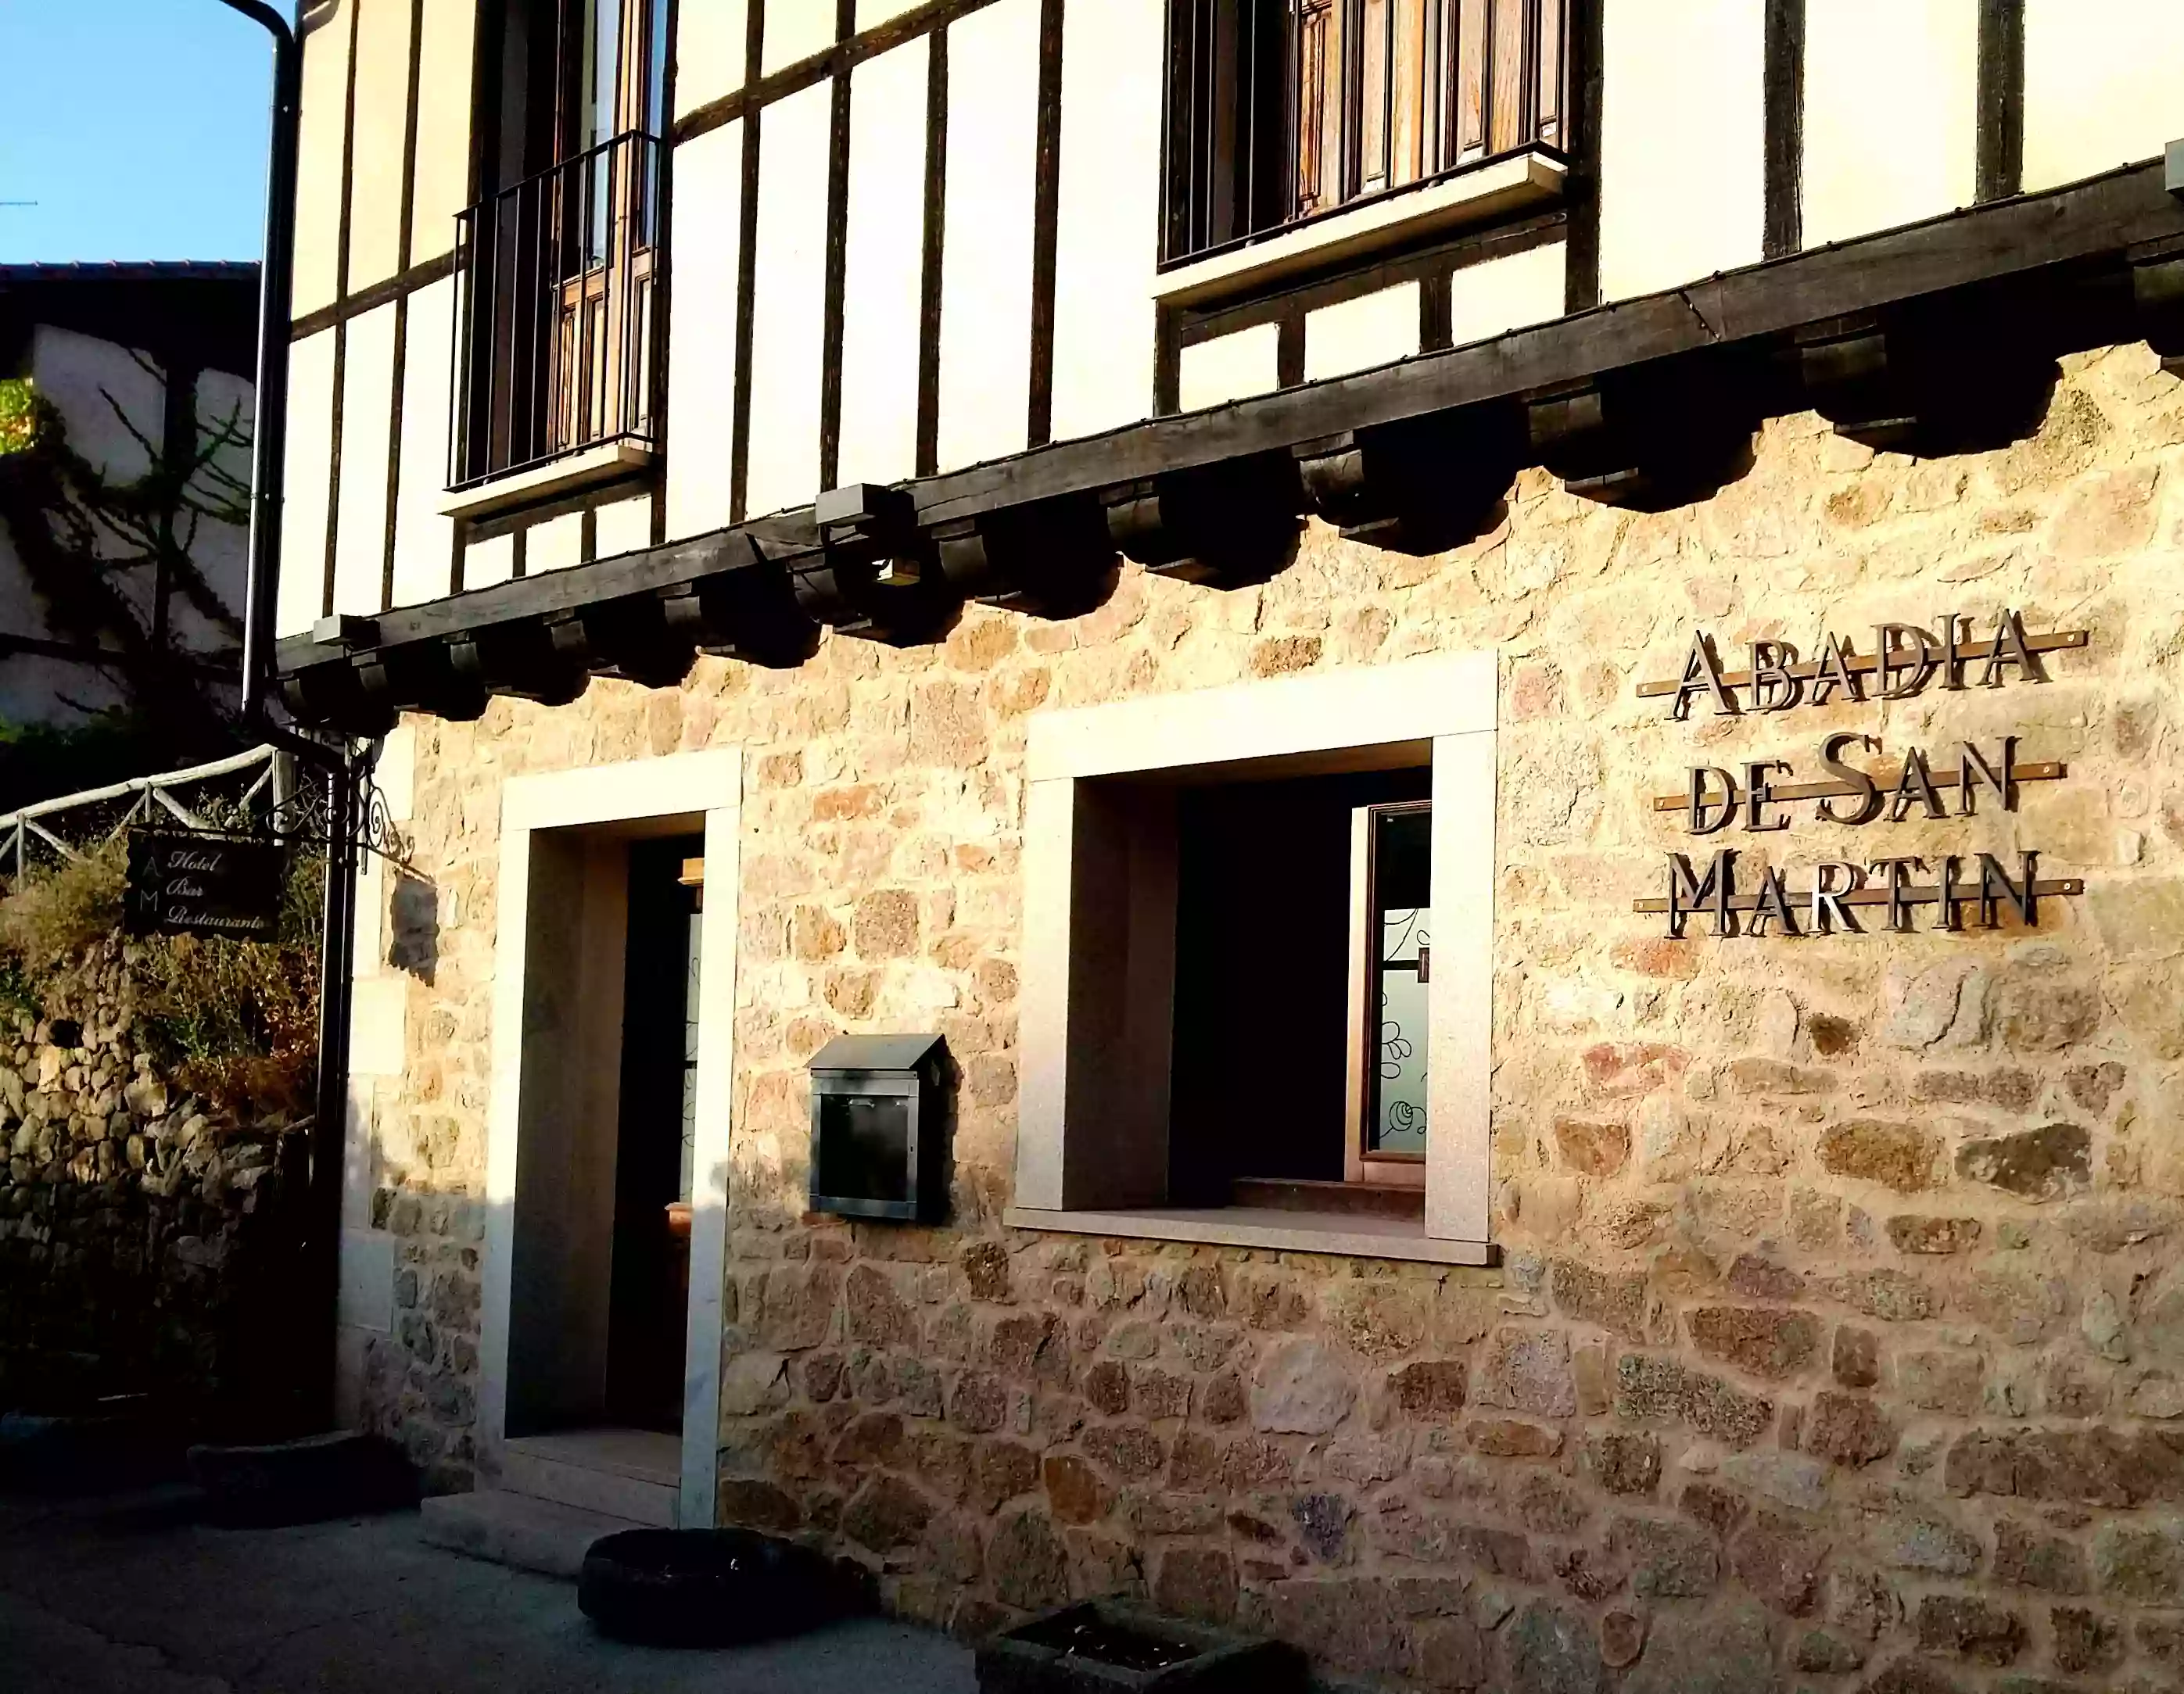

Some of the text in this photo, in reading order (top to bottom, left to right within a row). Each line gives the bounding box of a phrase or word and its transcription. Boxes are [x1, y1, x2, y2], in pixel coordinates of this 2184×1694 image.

[1663, 608, 2046, 721] ABADIA
[1683, 731, 2022, 835] DE SAN
[166, 876, 205, 897] Bar
[167, 850, 223, 872] Hotel
[1665, 848, 2042, 940] MARTIN
